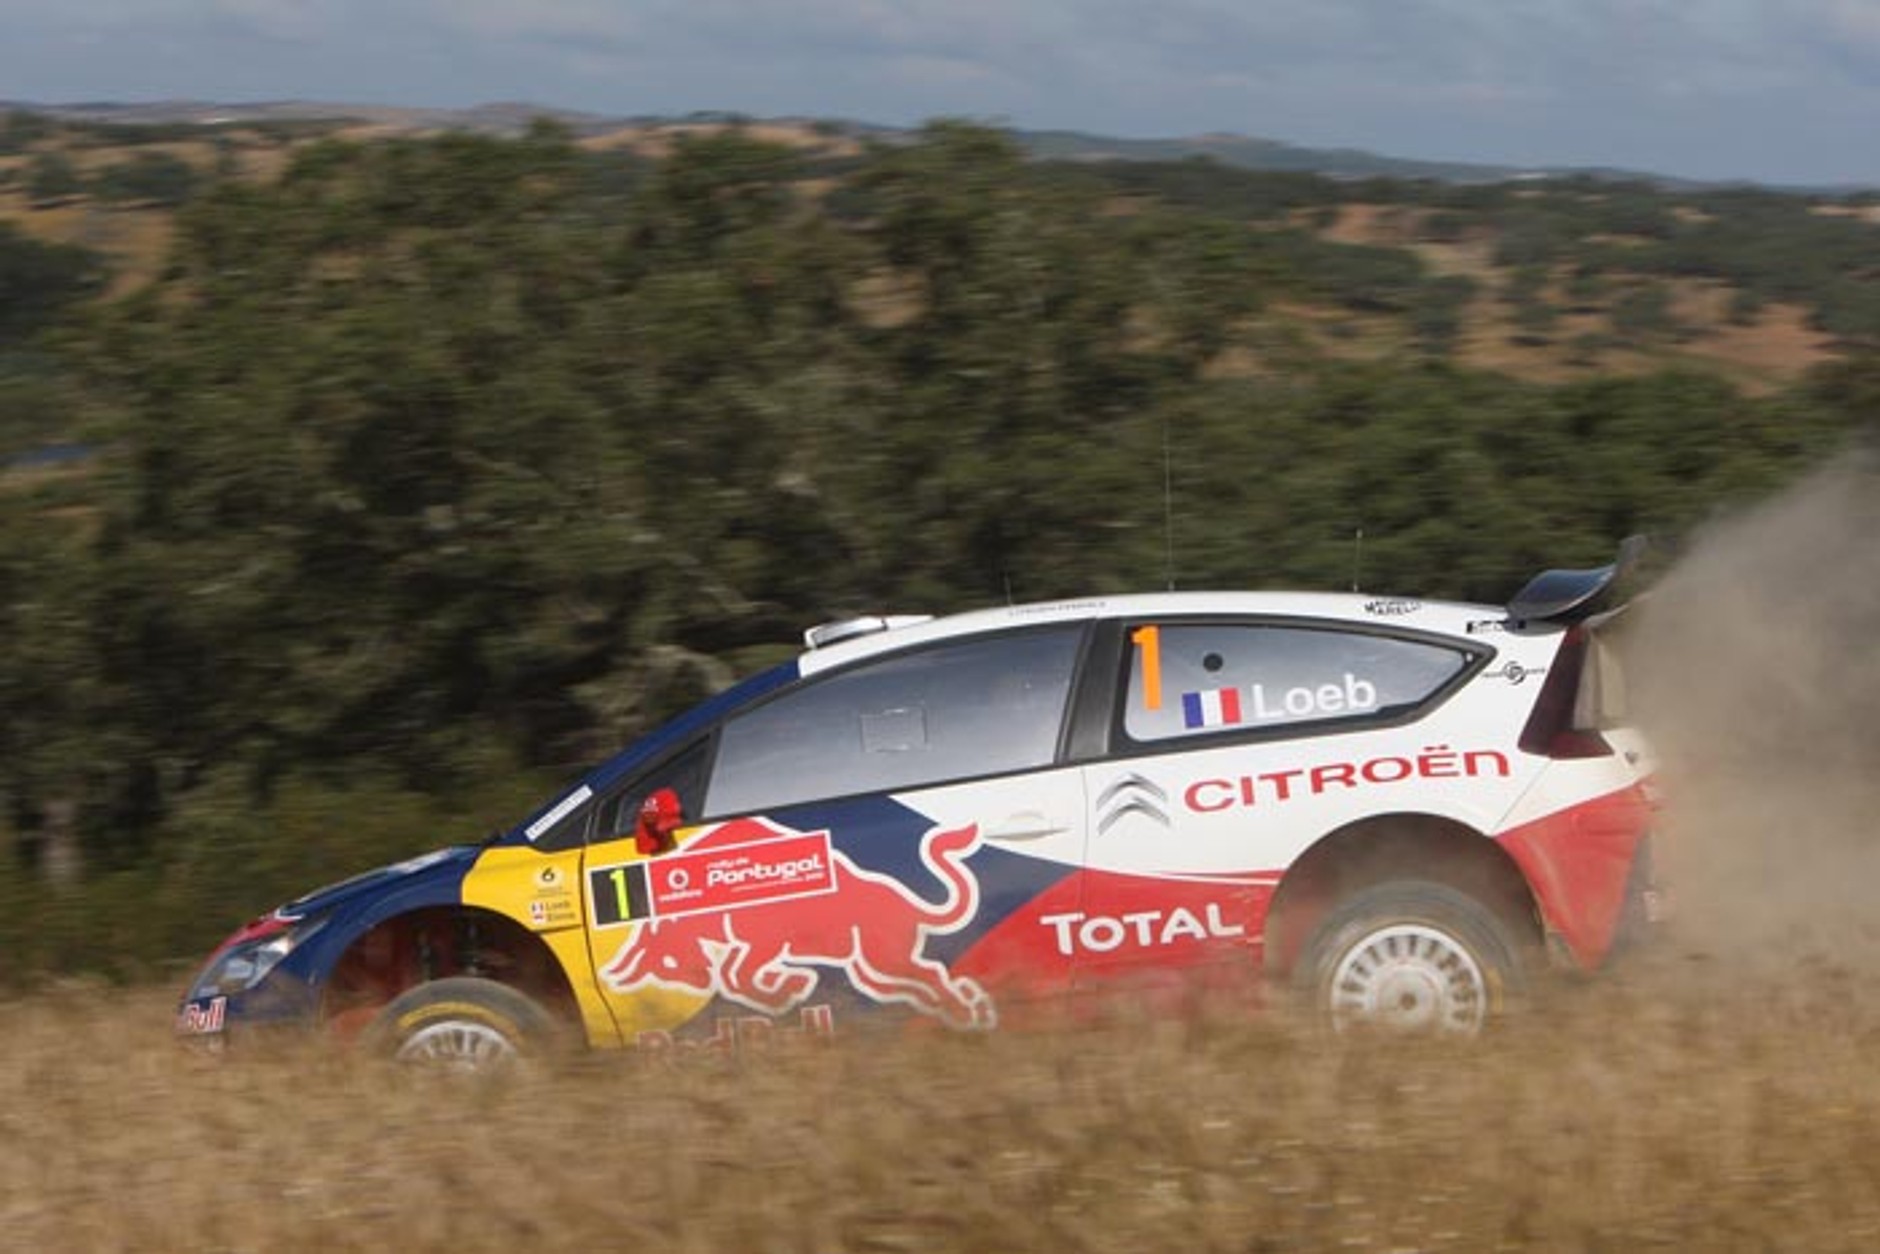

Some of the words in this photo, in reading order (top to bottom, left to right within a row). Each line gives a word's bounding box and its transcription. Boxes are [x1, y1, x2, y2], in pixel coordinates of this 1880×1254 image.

[1132, 625, 1161, 711] 1
[1253, 672, 1376, 719] Loeb
[609, 869, 631, 920] 1
[707, 853, 825, 888] Portugal
[1040, 903, 1245, 955] TOTAL
